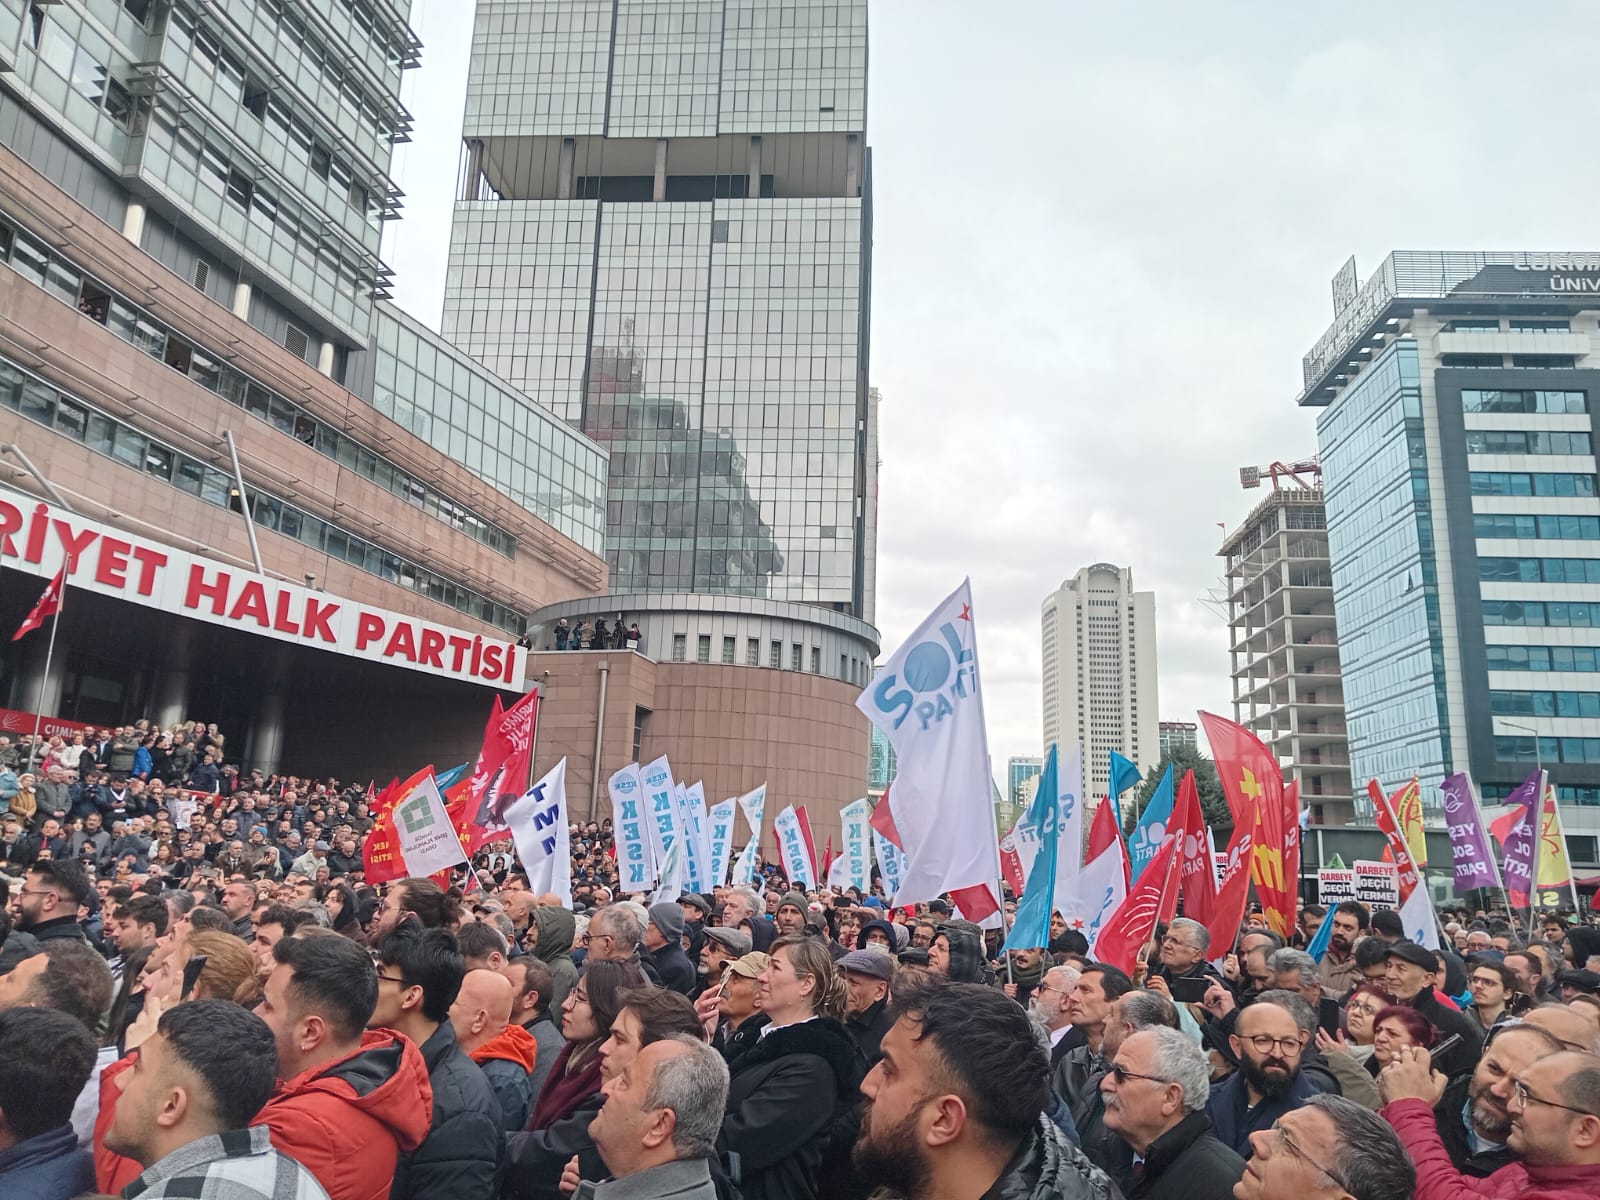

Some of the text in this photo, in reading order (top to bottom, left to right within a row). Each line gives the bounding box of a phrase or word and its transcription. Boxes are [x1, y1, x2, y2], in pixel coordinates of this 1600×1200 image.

[185, 563, 341, 644] HALK
[355, 609, 516, 684] PARTİSİ
[1320, 873, 1353, 881] DARBEYE
[1356, 866, 1394, 876] DARBEYE
[1324, 882, 1352, 895] GEÇİT
[1360, 877, 1391, 890] GEÇİT
[1356, 889, 1396, 901] VERME!
